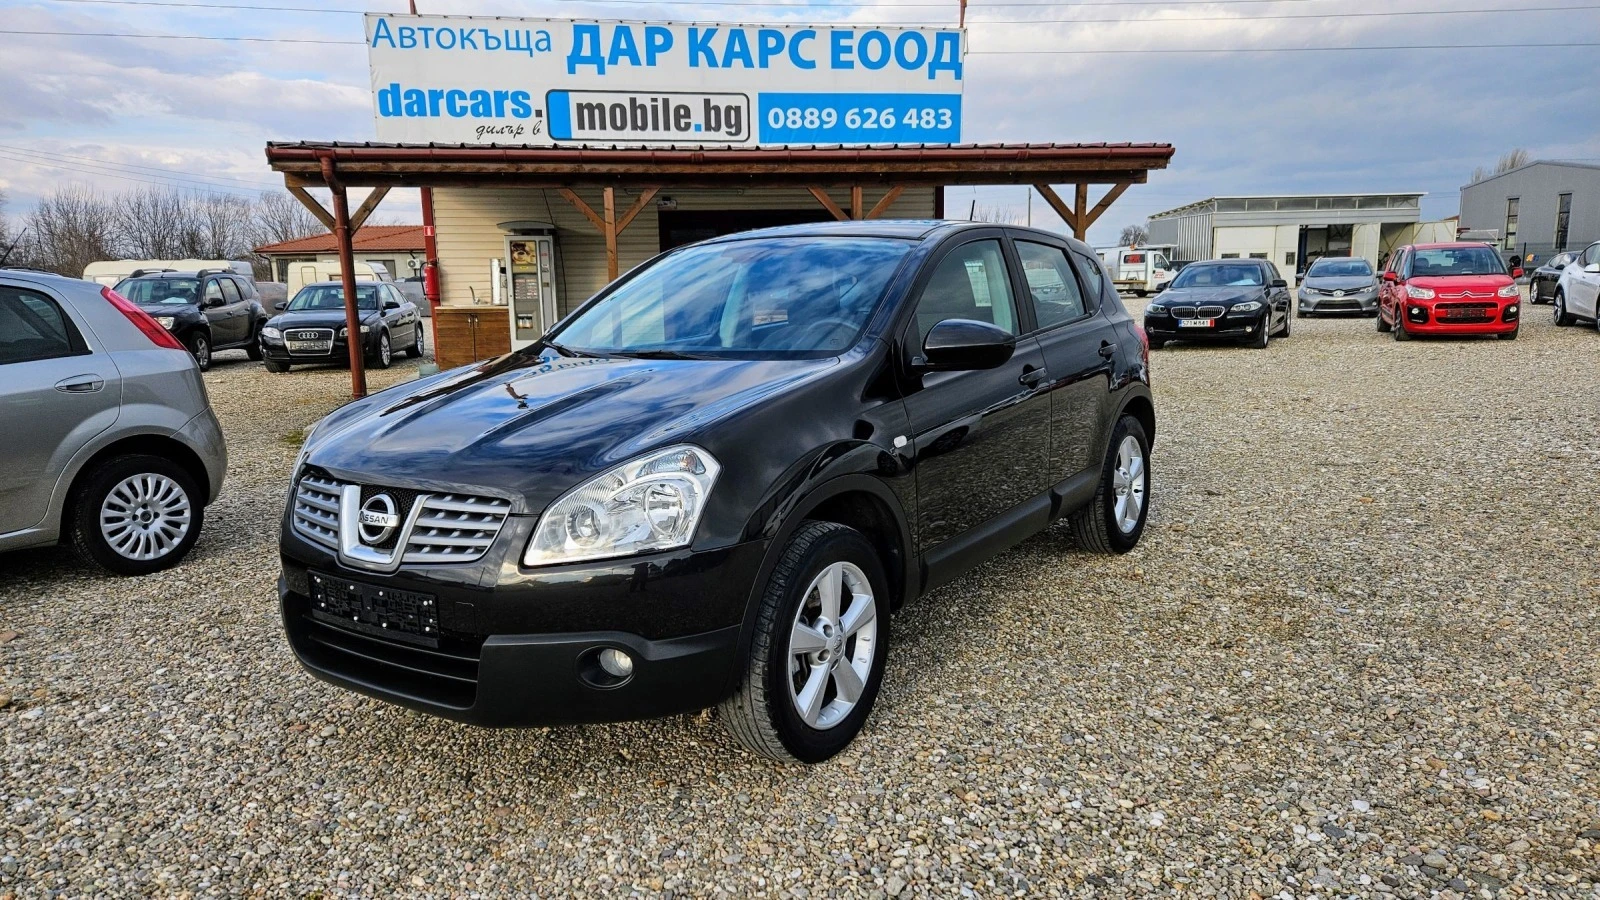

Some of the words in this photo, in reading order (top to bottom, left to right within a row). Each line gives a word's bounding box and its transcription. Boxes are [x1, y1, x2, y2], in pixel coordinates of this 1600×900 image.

[371, 17, 551, 57] Автокъща
[566, 24, 674, 75] ДАР
[688, 27, 817, 70] КАРС
[830, 30, 963, 80] ЕООД
[475, 124, 525, 140] дилър
[532, 119, 542, 136] в
[575, 96, 743, 136] mobile.bg
[767, 107, 838, 129] 0889
[844, 108, 896, 130] 626
[902, 108, 953, 130] 483
